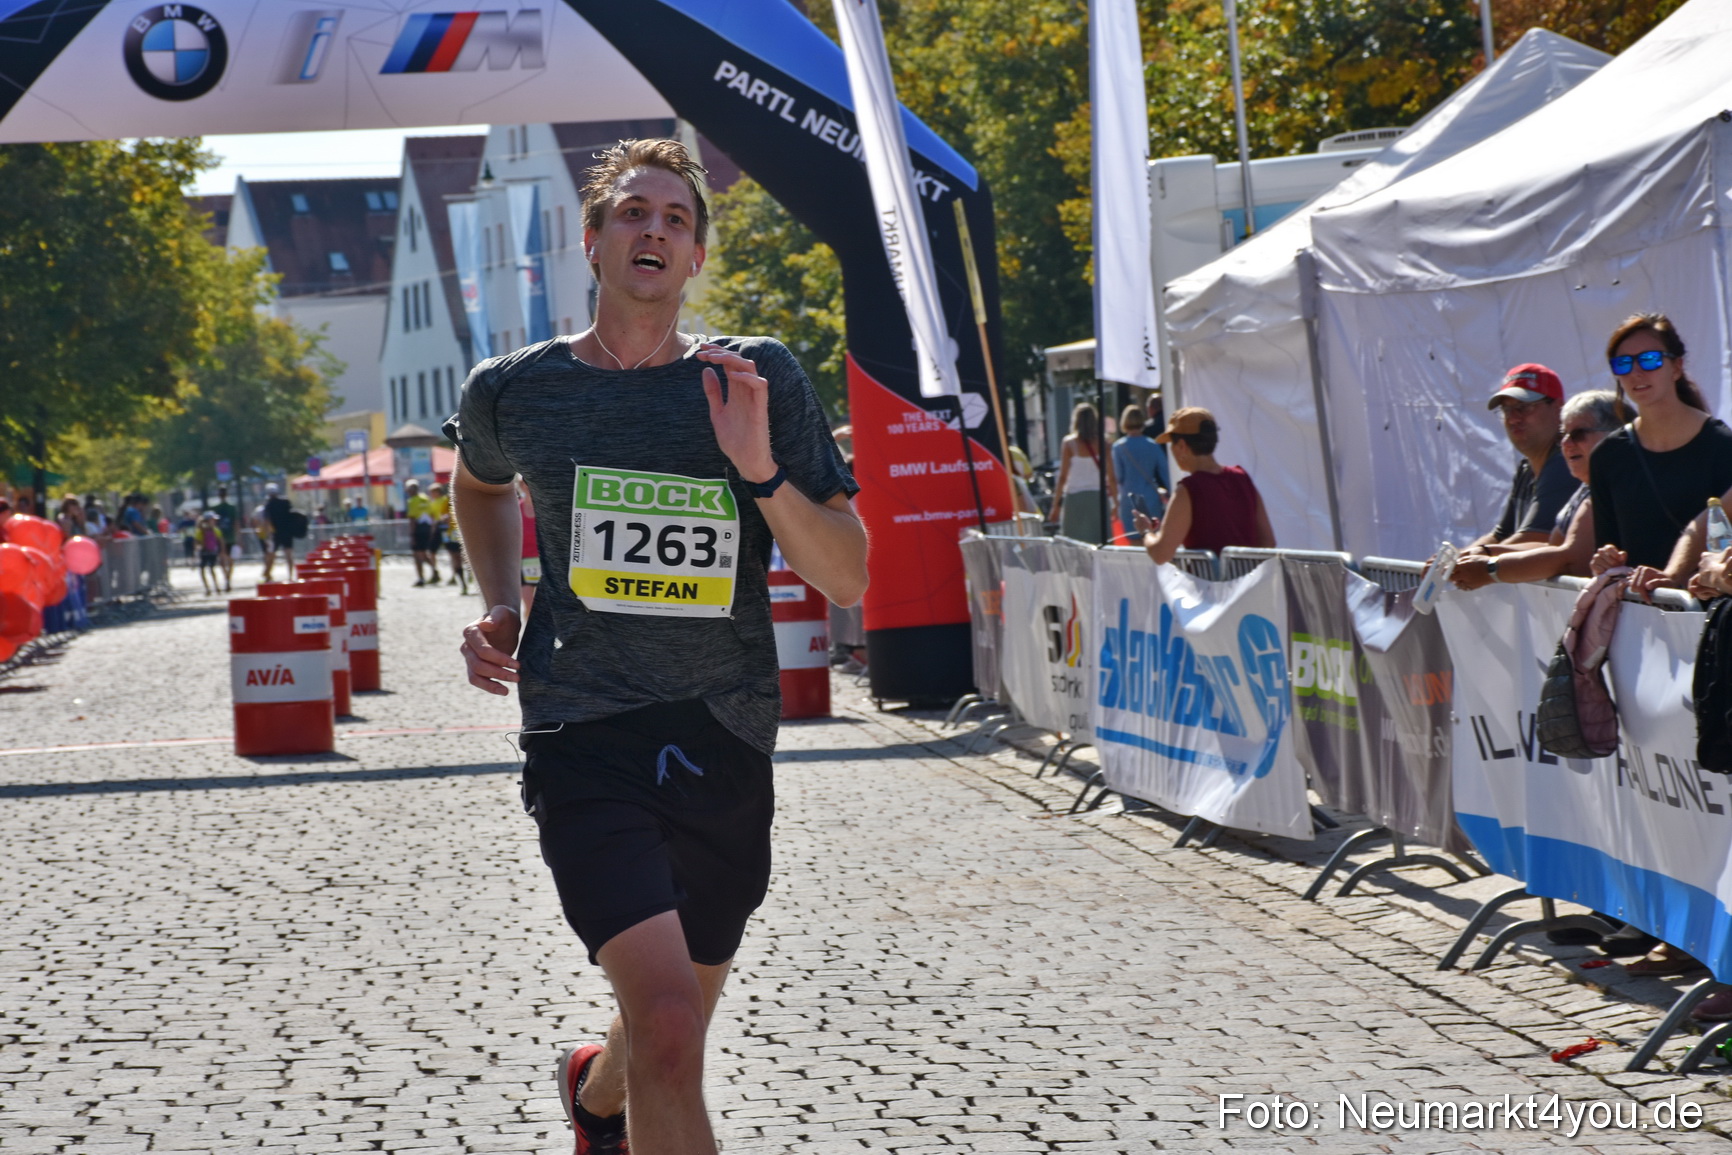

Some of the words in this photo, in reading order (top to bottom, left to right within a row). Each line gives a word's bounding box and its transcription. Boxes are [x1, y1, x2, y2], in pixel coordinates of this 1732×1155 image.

[131, 4, 218, 34] BMW
[713, 60, 797, 123] PARTL
[886, 424, 904, 434] 100
[905, 421, 940, 432] YEARS
[902, 412, 922, 422] THE
[925, 409, 951, 420] NEXT
[889, 462, 927, 477] BMW
[588, 475, 726, 515] BOCK
[593, 520, 717, 568] 1263
[604, 577, 698, 600] STEFAN
